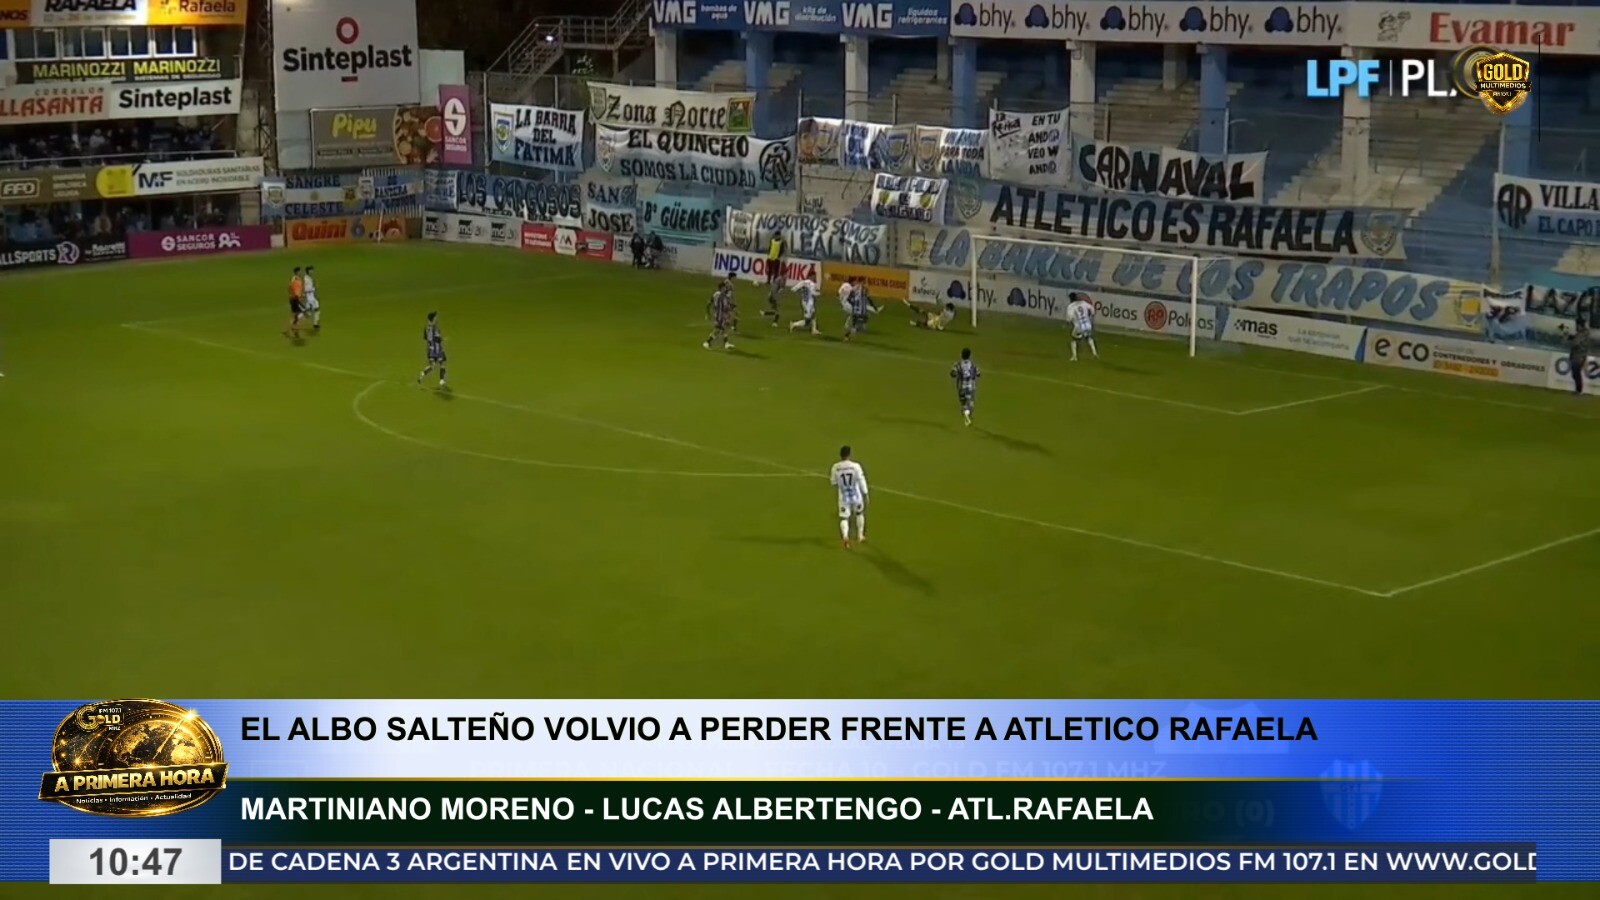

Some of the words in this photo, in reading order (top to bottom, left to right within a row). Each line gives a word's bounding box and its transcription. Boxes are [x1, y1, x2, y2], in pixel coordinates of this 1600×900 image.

[653, 1, 696, 24] VMG
[743, 1, 790, 25] VMG
[842, 3, 892, 28] VMG
[1429, 11, 1576, 47] Evamar
[33, 63, 126, 79] MARINOZZI
[133, 59, 221, 75] MARINOZZI
[283, 45, 413, 74] Sinteplast
[118, 86, 233, 111] Sinteplast
[515, 108, 532, 129] LA
[535, 110, 577, 135] BARRA
[607, 95, 657, 124] Zona
[662, 100, 726, 130] Norte
[532, 129, 556, 144] DEL
[627, 129, 653, 148] EL
[657, 132, 750, 159] QUINCHO
[514, 139, 578, 167] FATIMA
[285, 175, 341, 189] SANGRE
[620, 158, 676, 181] SOMOS
[679, 164, 699, 182] LA
[700, 165, 756, 188] CIUDAD
[1078, 144, 1256, 201] CARNAVAL
[457, 171, 487, 207] LOS
[587, 182, 618, 204] SAN
[1539, 184, 1600, 211] VILLA
[284, 202, 345, 216] CELESTE
[587, 208, 635, 234] JOSE
[660, 201, 721, 232] GÜEMES
[990, 185, 1155, 241] ATLETICO
[1161, 199, 1204, 244] ES
[1207, 204, 1358, 255] RAFAELA
[176, 234, 216, 243] SANCOR
[292, 220, 348, 241] Quini
[756, 213, 829, 234] NOSOTROS
[831, 219, 879, 244] SOMOS
[176, 241, 217, 251] SEGUROS
[714, 252, 818, 284] INDUQMIKA
[929, 229, 971, 268] LA
[977, 240, 1104, 283] BARRA
[1112, 253, 1168, 291] DE
[1271, 263, 1452, 322] TRAPOS
[1094, 301, 1138, 321] Poleas
[1168, 310, 1215, 330] Polas
[1242, 319, 1279, 336] mas
[840, 473, 853, 487] 17
